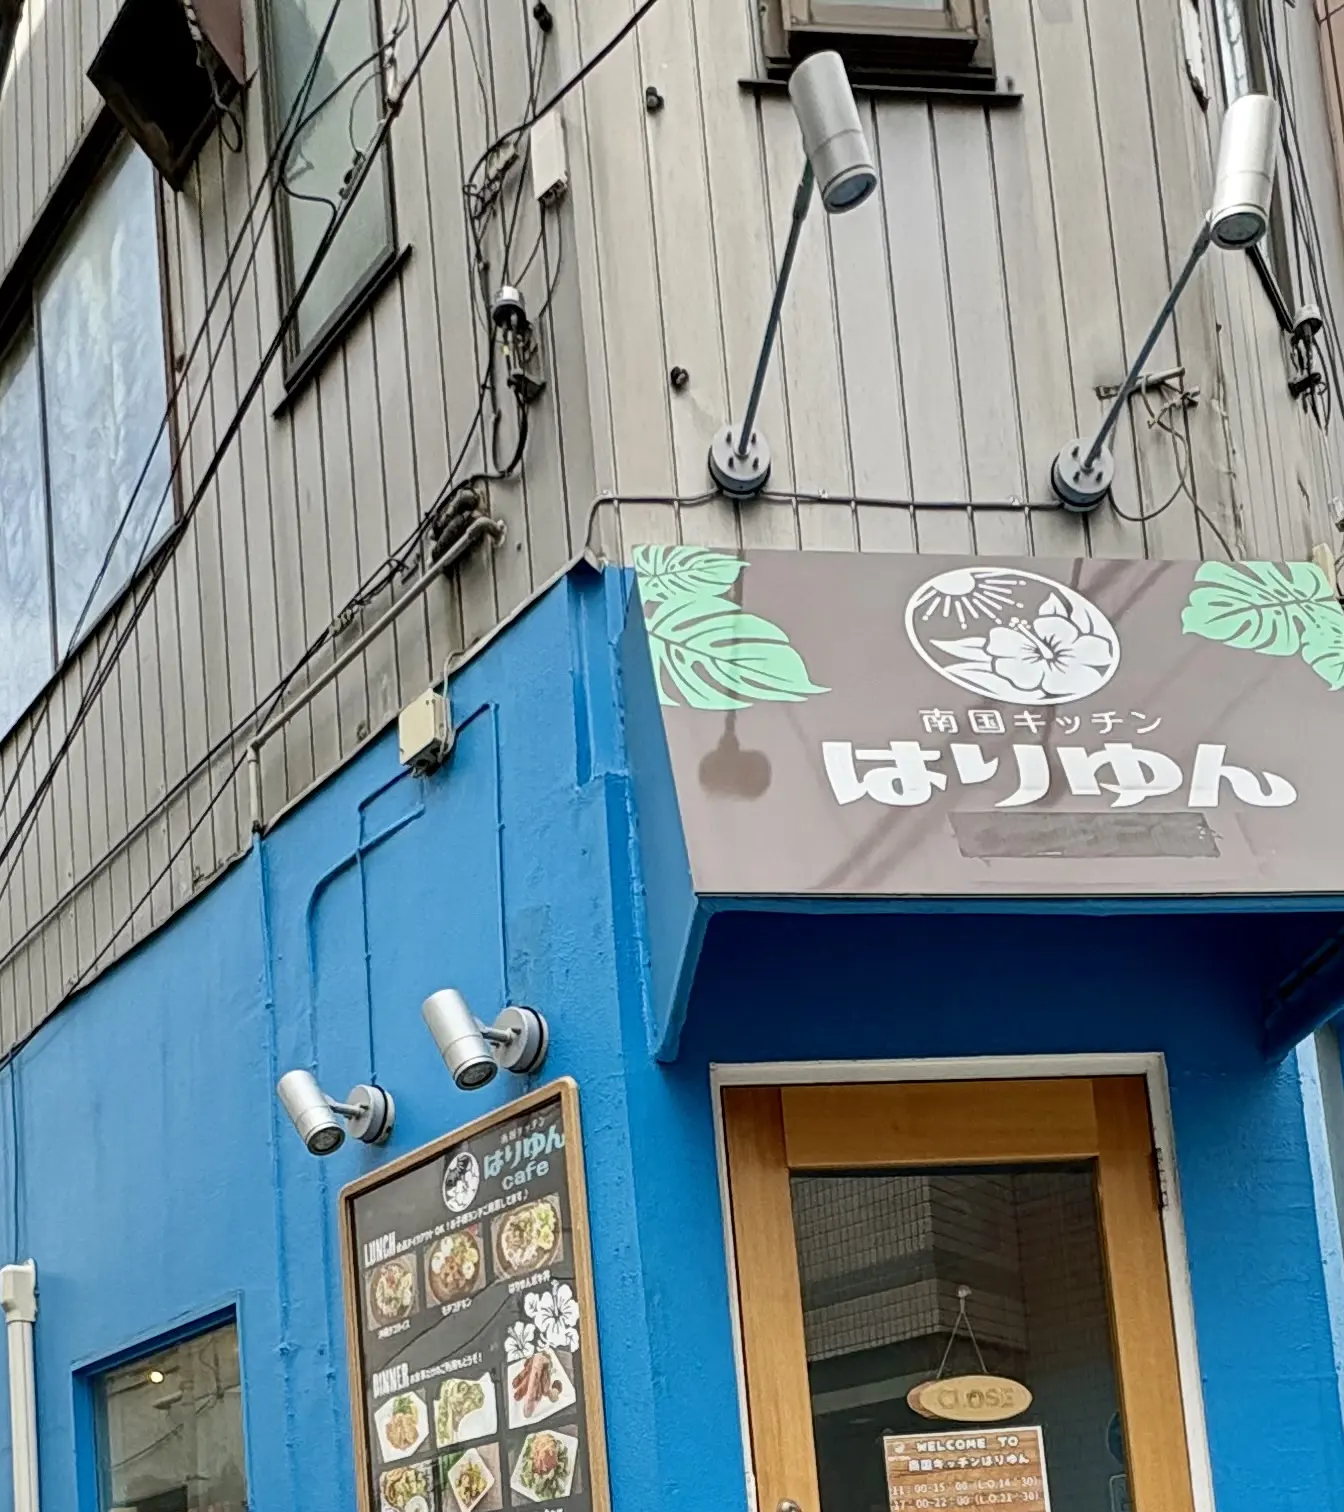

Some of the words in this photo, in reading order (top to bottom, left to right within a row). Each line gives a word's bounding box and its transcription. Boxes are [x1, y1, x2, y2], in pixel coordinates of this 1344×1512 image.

[918, 707, 1164, 738] 南国キッチン
[820, 740, 1301, 809] はりゅん
[483, 1128, 566, 1180] はりゅん
[501, 1158, 550, 1191] cafe
[364, 1231, 397, 1268] LUNCH
[373, 1363, 411, 1399] DINNER
[937, 1386, 1014, 1410] CLOSE
[916, 1437, 987, 1452] WELCOME
[997, 1435, 1019, 1448] TO
